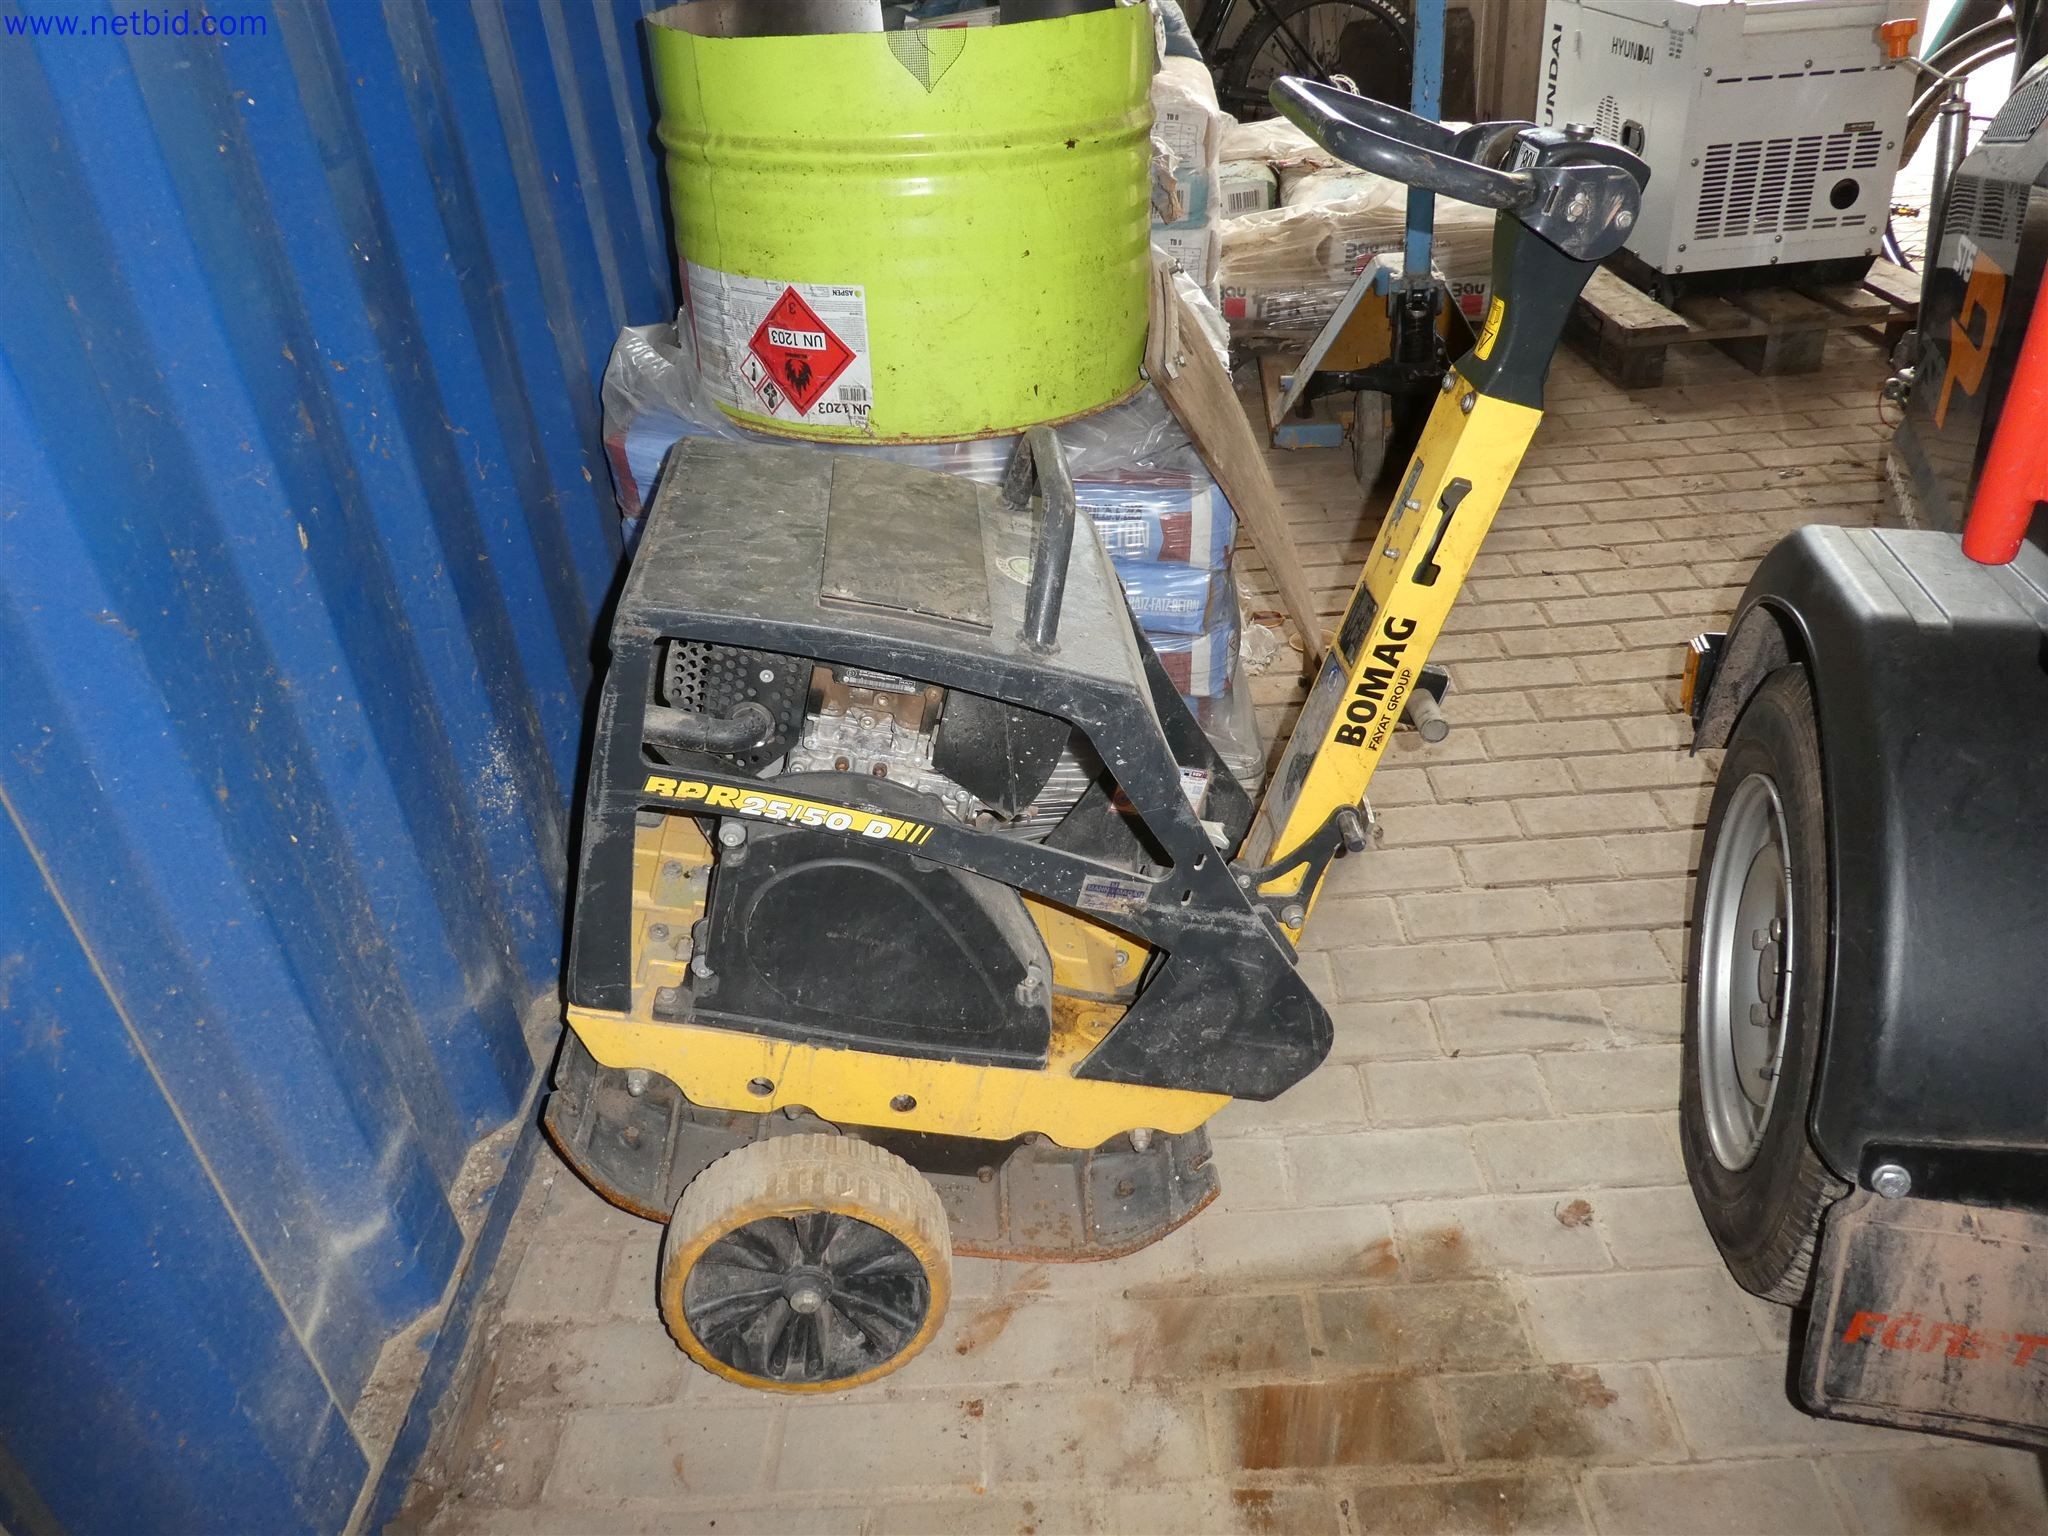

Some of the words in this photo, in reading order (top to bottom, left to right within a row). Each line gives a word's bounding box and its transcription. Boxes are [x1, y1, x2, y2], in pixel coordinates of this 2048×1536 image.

[1371, 0, 1406, 25] XXIS
[1611, 36, 1655, 65] HYUNDAI
[1544, 23, 1563, 128] UNDAI
[832, 289, 853, 297] ASPEN
[1219, 286, 1247, 298] au
[788, 302, 796, 314] 3
[771, 330, 798, 346] 1203
[803, 334, 823, 347] UN
[818, 402, 850, 414] 1203
[1334, 616, 1417, 747] BOMAG
[1368, 715, 1391, 751] FAYAT
[1387, 668, 1412, 711] GROUP
[644, 776, 741, 809] RPR
[739, 797, 853, 831] 25/50
[862, 819, 893, 839] D
[1841, 1311, 2048, 1368] FÖRT
